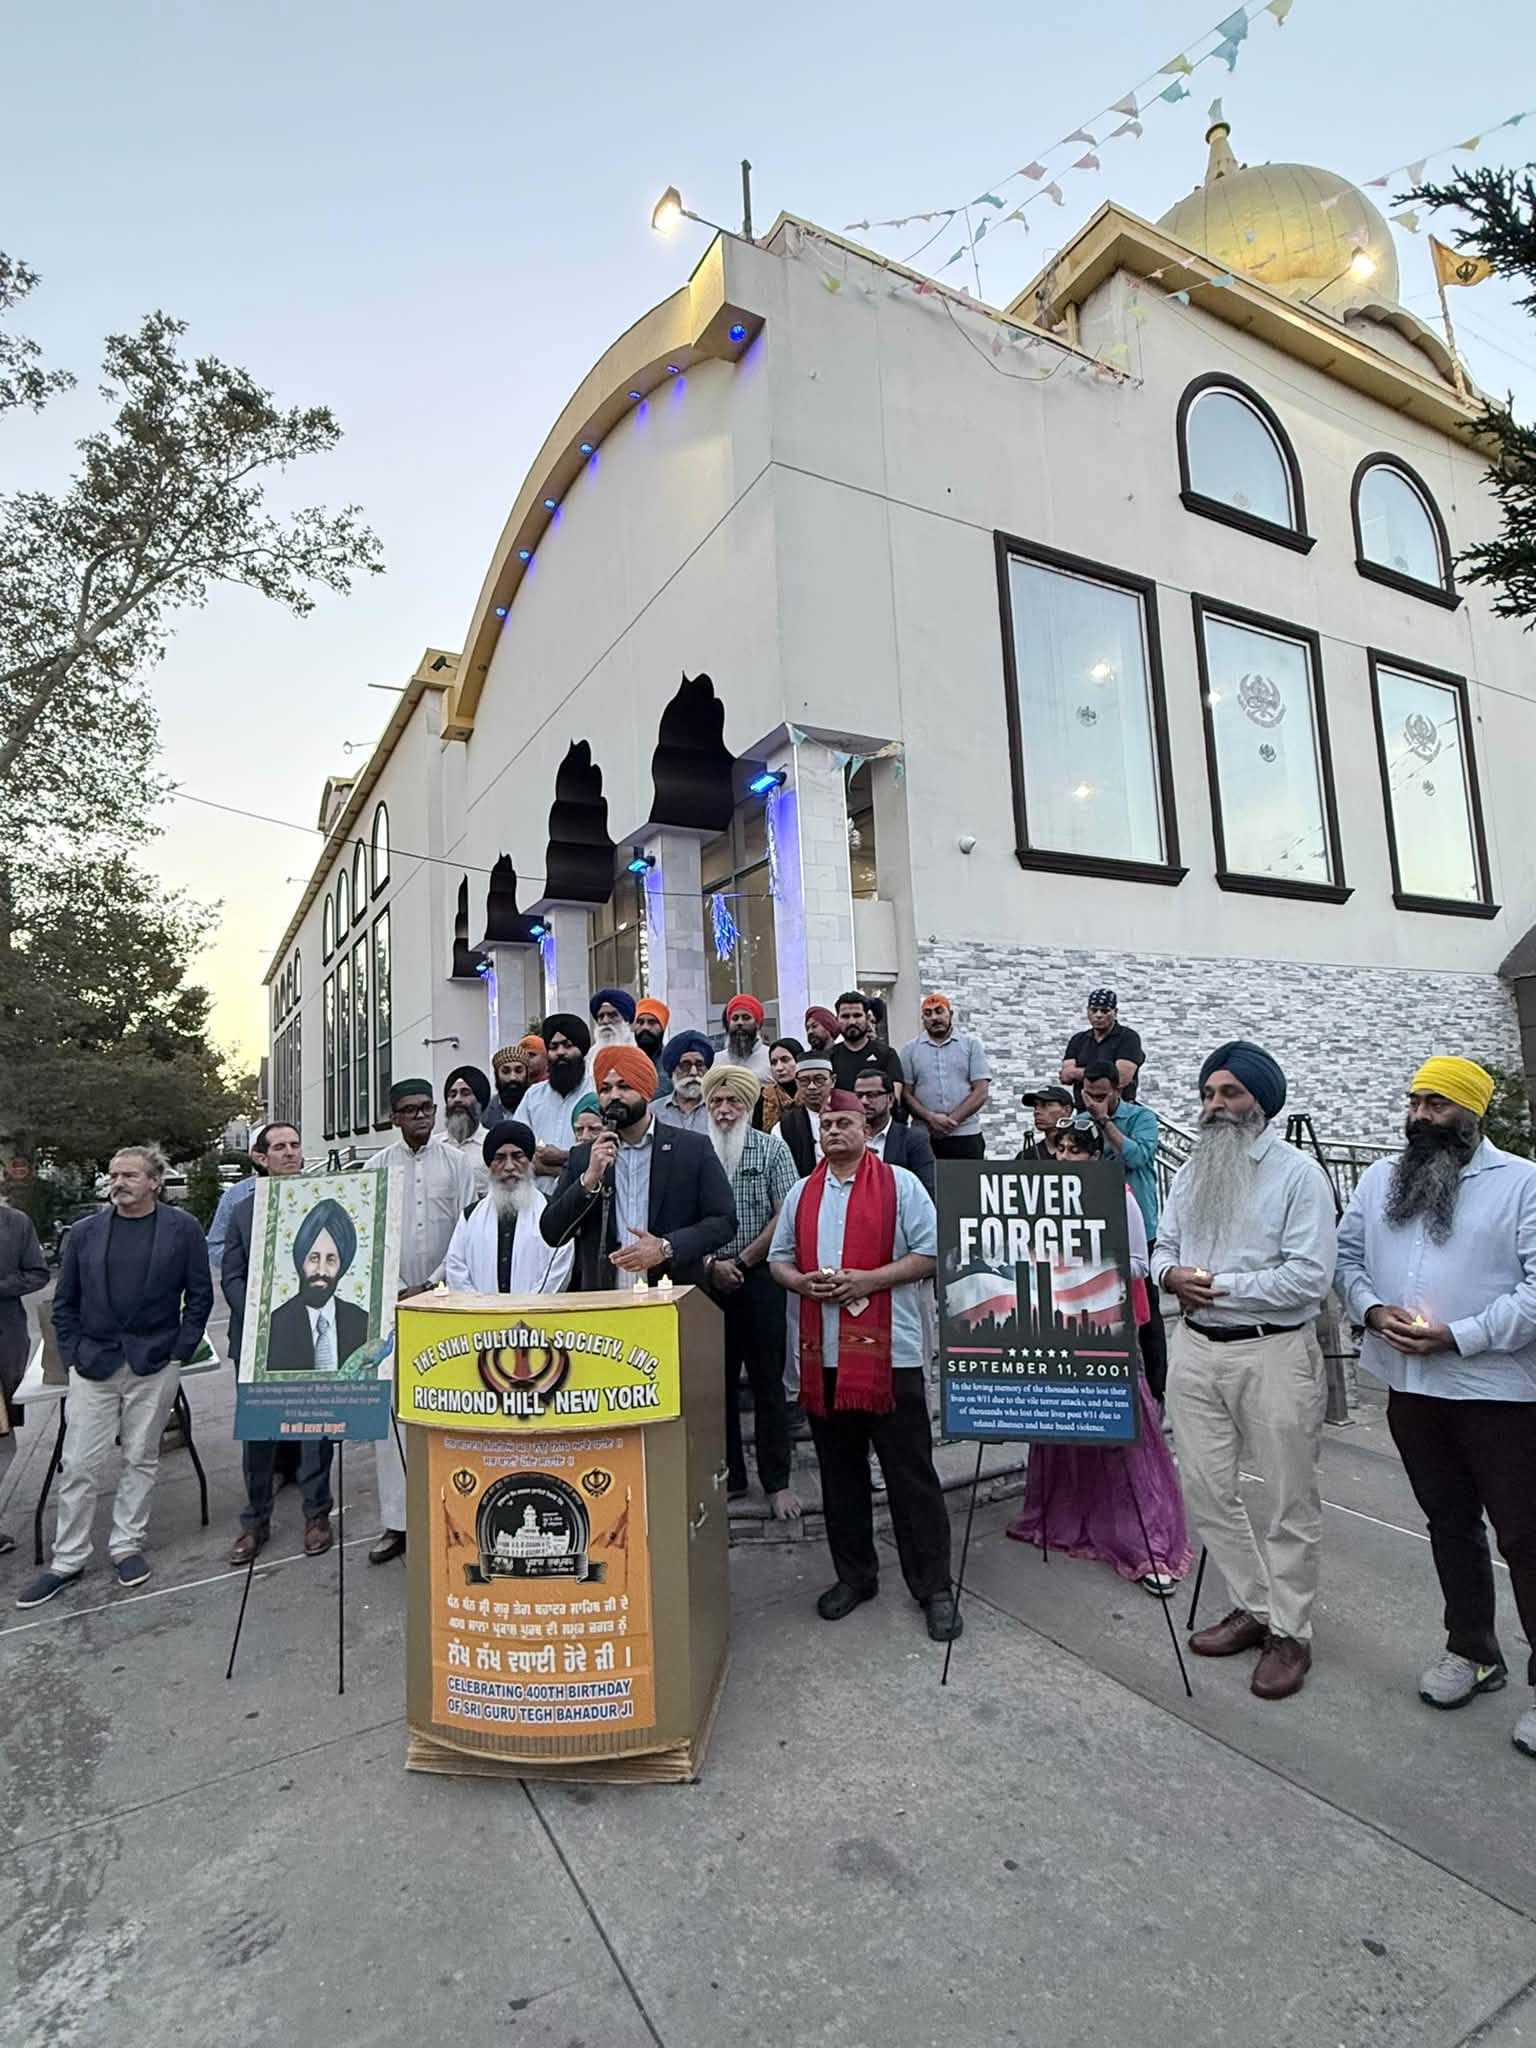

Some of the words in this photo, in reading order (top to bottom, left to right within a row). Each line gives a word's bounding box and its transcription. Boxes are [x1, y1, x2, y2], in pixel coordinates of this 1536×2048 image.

[979, 1174, 1084, 1215] NEVER
[959, 1217, 1107, 1268] FORGET
[413, 1347, 438, 1375] THE
[437, 1335, 470, 1361] SIKH
[473, 1328, 548, 1351] CULTURAL
[627, 1345, 659, 1380] INC.
[947, 1360, 1048, 1375] SEPTEMBER
[1057, 1364, 1077, 1377] 11,
[1086, 1364, 1129, 1377] 2001
[414, 1386, 498, 1414] RICHMOND
[503, 1391, 544, 1414] HILL
[555, 1388, 599, 1414] NEW
[604, 1383, 660, 1410] YORK
[961, 1382, 971, 1390] the
[973, 1382, 994, 1393] loving
[994, 1385, 1022, 1394] memory
[1023, 1384, 1032, 1392] of
[1032, 1384, 1043, 1392] the
[1080, 1386, 1095, 1394] who
[1096, 1386, 1109, 1394] lost
[960, 1406, 968, 1414] of
[1004, 1408, 1018, 1416] who
[1020, 1408, 1032, 1416] lost
[1098, 1411, 1112, 1420] due
[1113, 1412, 1121, 1420] to
[992, 1396, 1005, 1404] due
[1014, 1396, 1026, 1404] the
[1088, 1399, 1101, 1407] and
[1102, 1398, 1114, 1408] the
[291, 1422, 303, 1433] will
[304, 1423, 323, 1433] never
[1024, 1421, 1038, 1430] and
[508, 1645, 556, 1673] ਵਧਾਈ
[594, 1641, 615, 1670] ਜੀ
[448, 1677, 523, 1699] CELEBRATING
[526, 1686, 565, 1700] 400TH
[568, 1680, 631, 1698] BIRTHDAY
[448, 1698, 462, 1712] OF
[464, 1701, 481, 1717] SRI
[484, 1705, 516, 1721] GURU
[520, 1708, 552, 1722] TEGH
[556, 1704, 618, 1722] BAHADUR
[620, 1702, 632, 1716] JI
